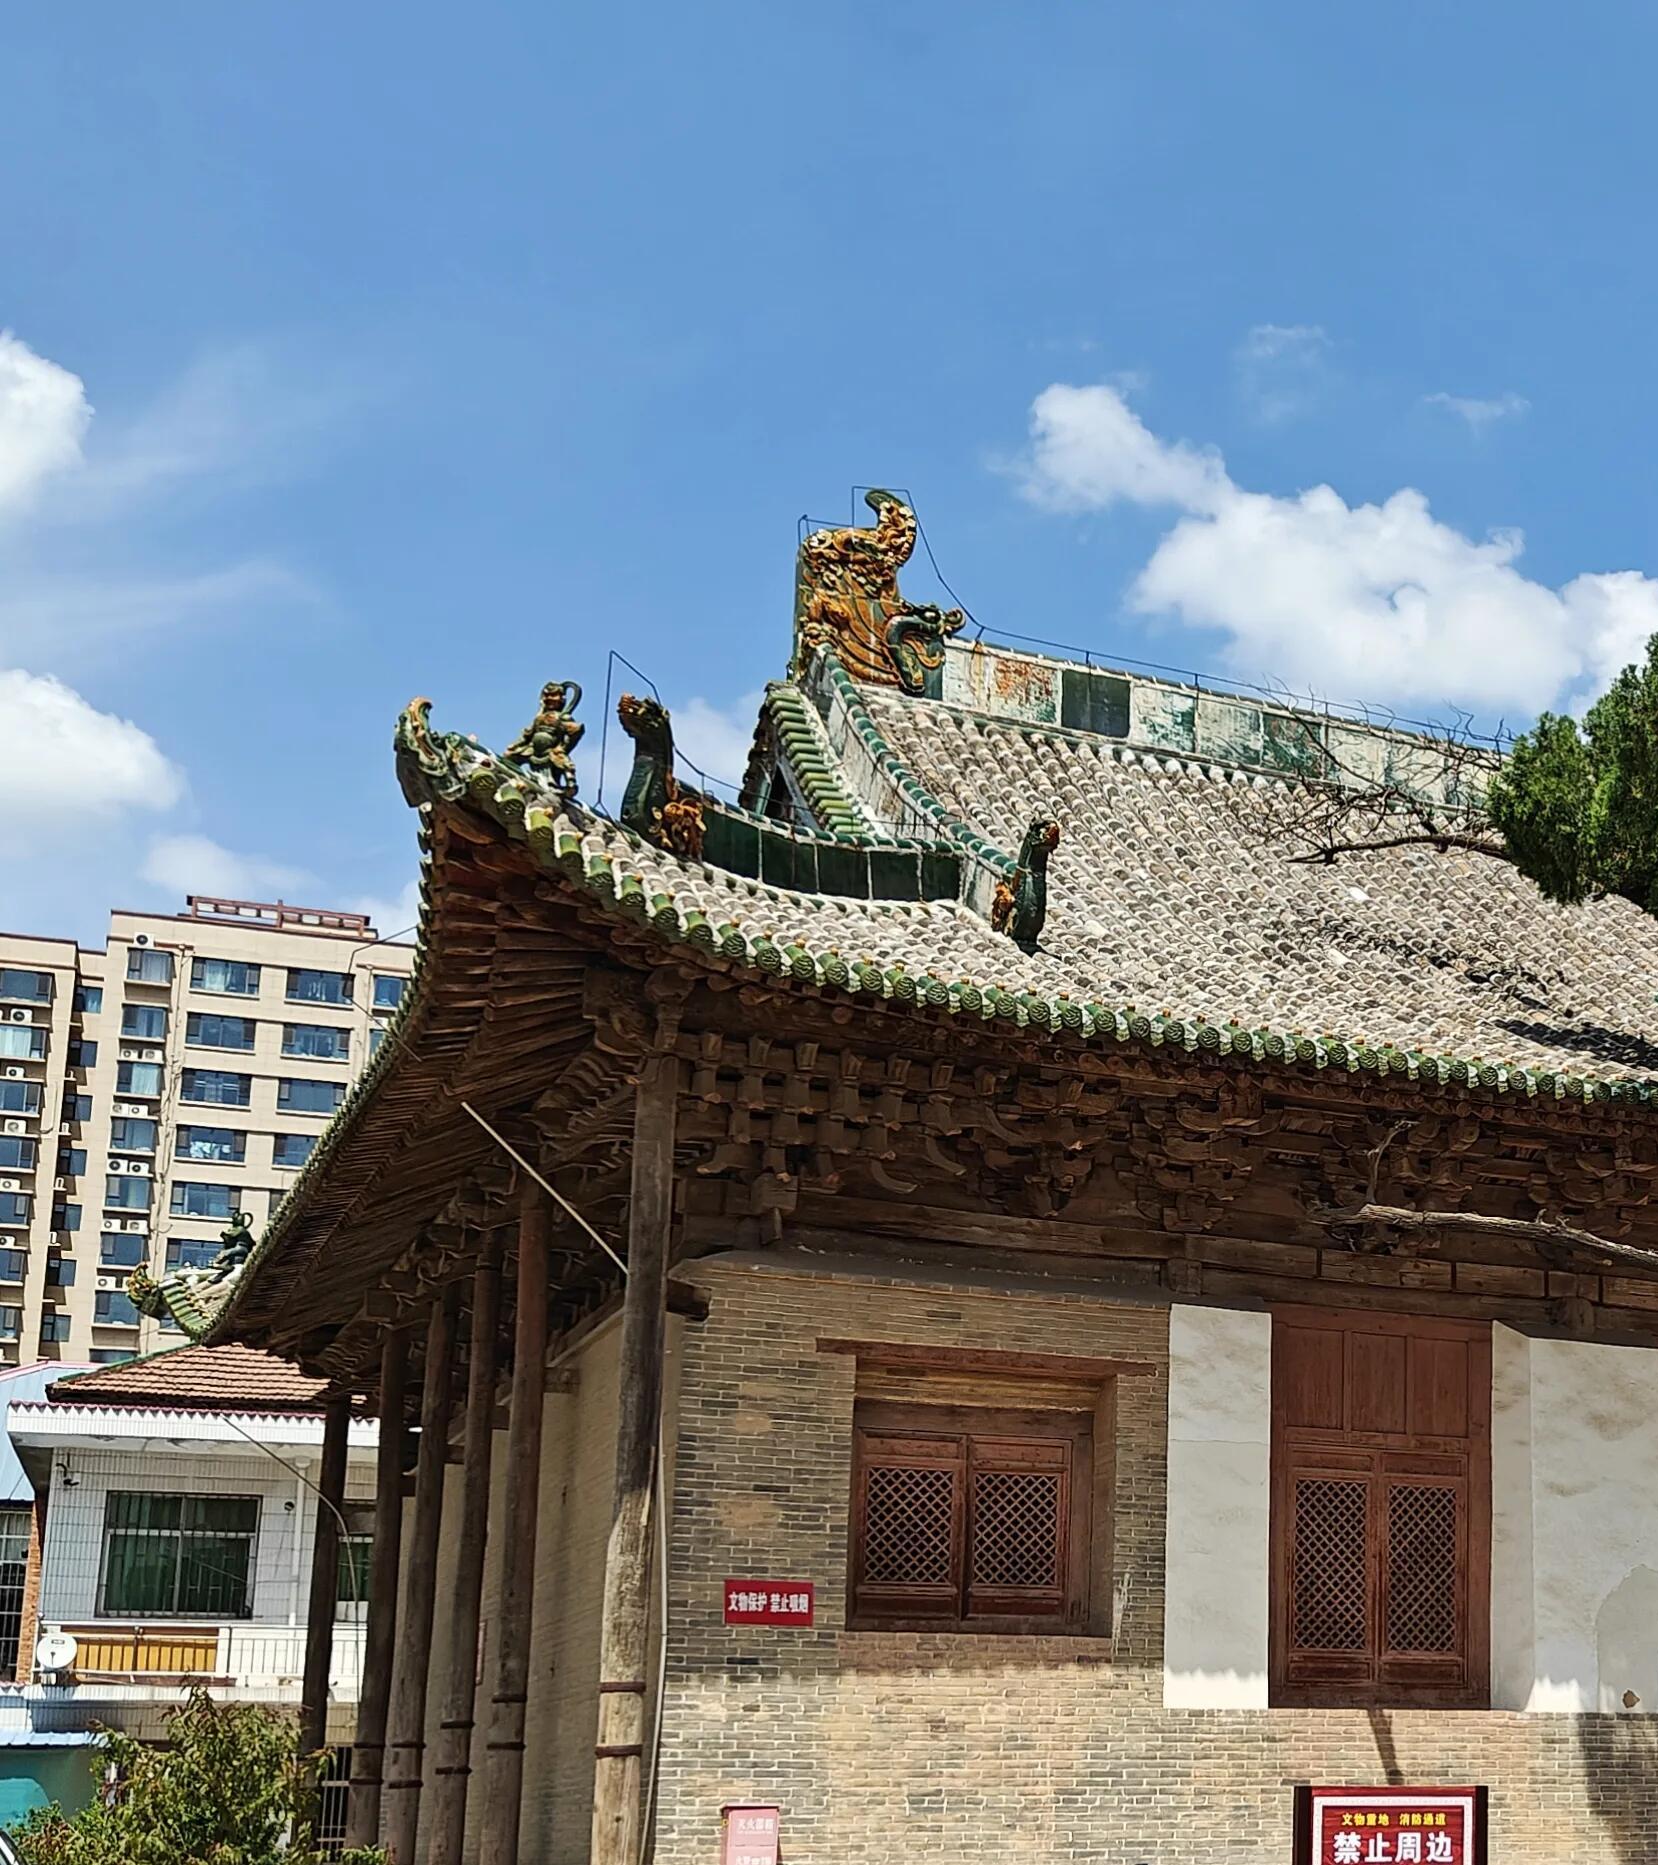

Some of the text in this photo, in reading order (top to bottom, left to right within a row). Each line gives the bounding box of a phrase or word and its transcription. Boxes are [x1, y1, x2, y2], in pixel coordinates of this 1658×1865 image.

[728, 1591, 767, 1612] 文物保护
[1341, 1813, 1446, 1826] 文物重地 消防通道
[1333, 1831, 1453, 1863] 禁止周边
